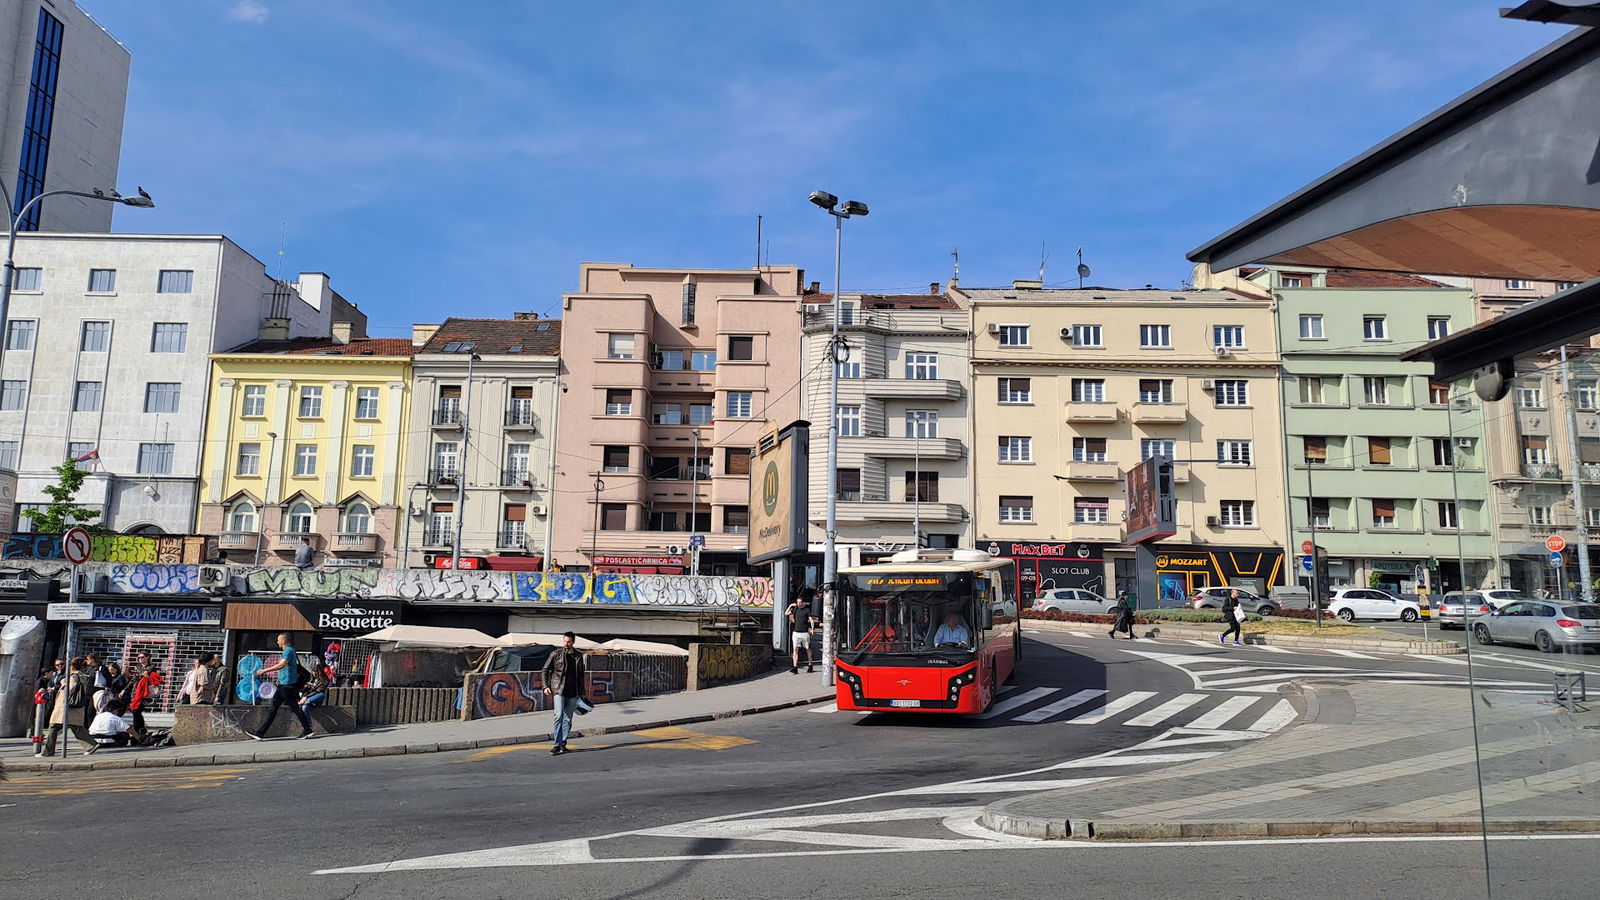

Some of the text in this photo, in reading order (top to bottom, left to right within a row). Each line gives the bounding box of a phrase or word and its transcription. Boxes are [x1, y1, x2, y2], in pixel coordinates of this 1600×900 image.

[759, 523, 781, 538] McDelivery
[1011, 543, 1066, 556] MAXBET
[605, 556, 668, 565] POSLASTIČARNICA
[1170, 558, 1208, 566] MOZZART
[1051, 567, 1090, 575] SLOT CLUB
[93, 606, 200, 621] ПАРФИМЕРИЈА
[318, 613, 393, 631] Baguette
